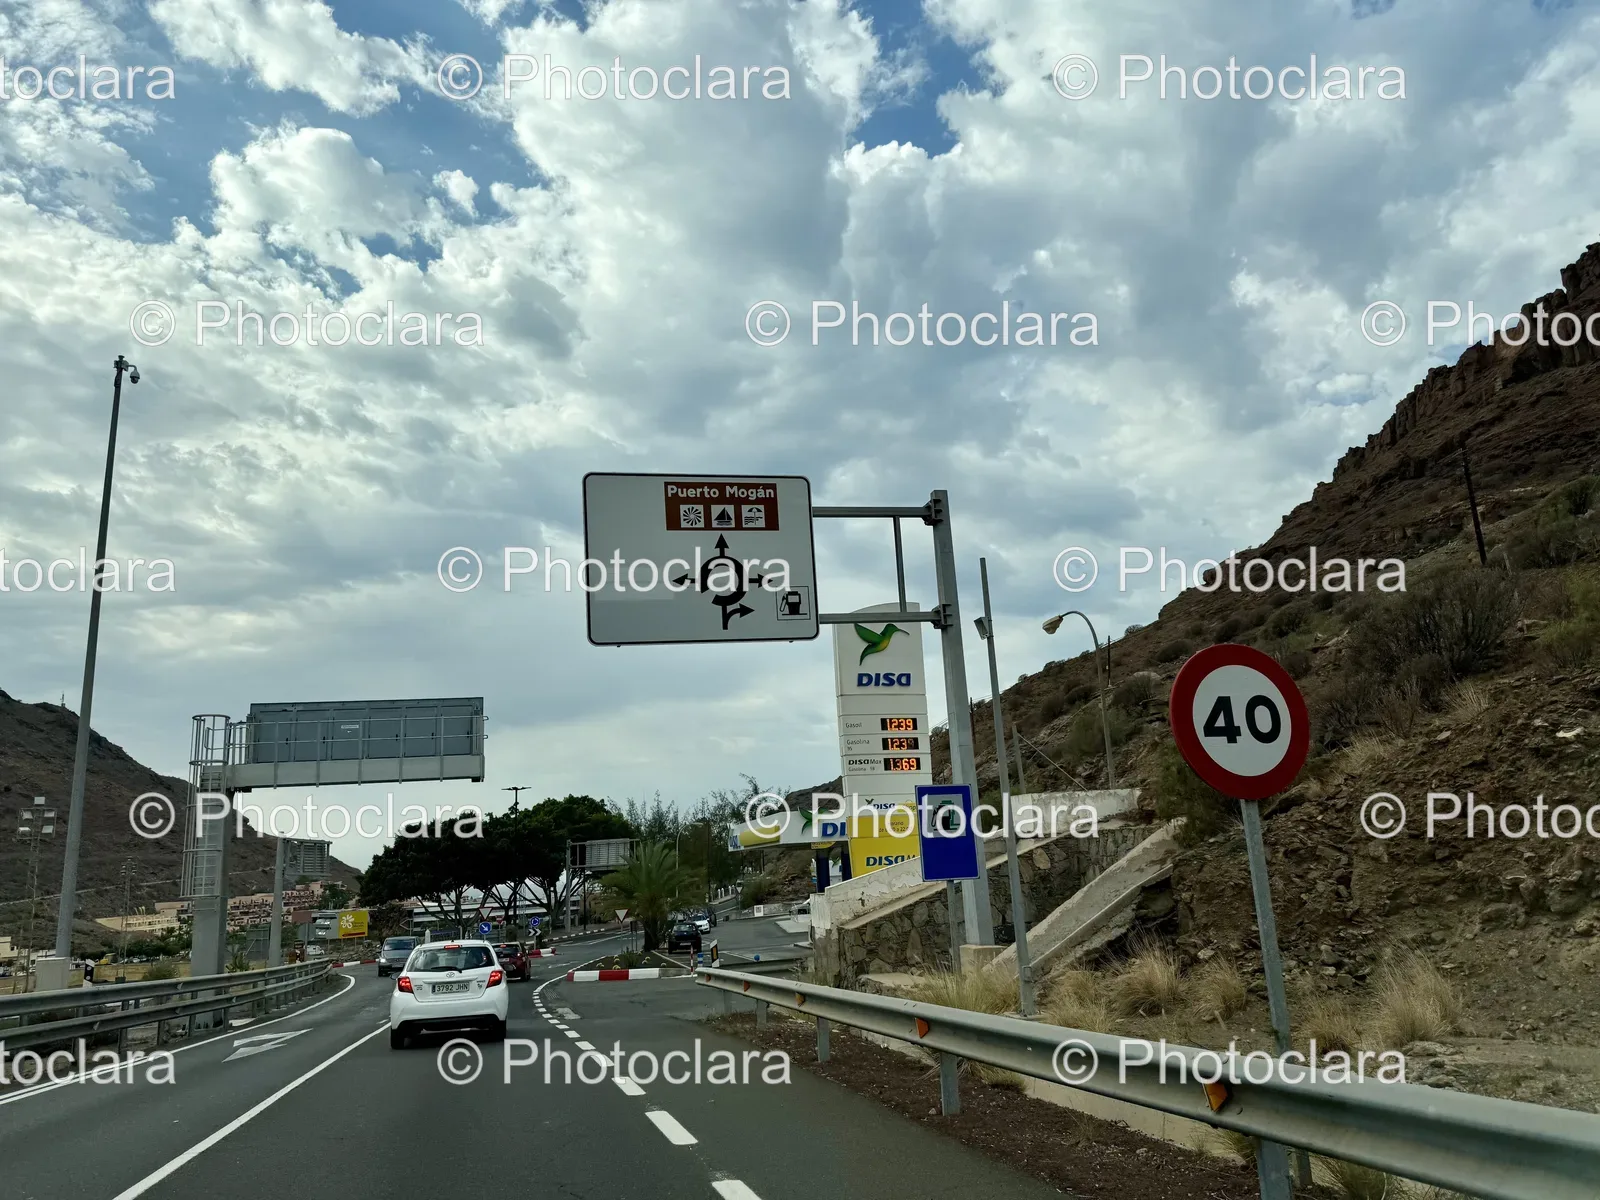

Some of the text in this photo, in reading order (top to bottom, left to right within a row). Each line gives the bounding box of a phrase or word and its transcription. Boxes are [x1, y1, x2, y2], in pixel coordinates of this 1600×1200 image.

[667, 484, 774, 500] Puerto Mogán
[1203, 694, 1281, 744] 40
